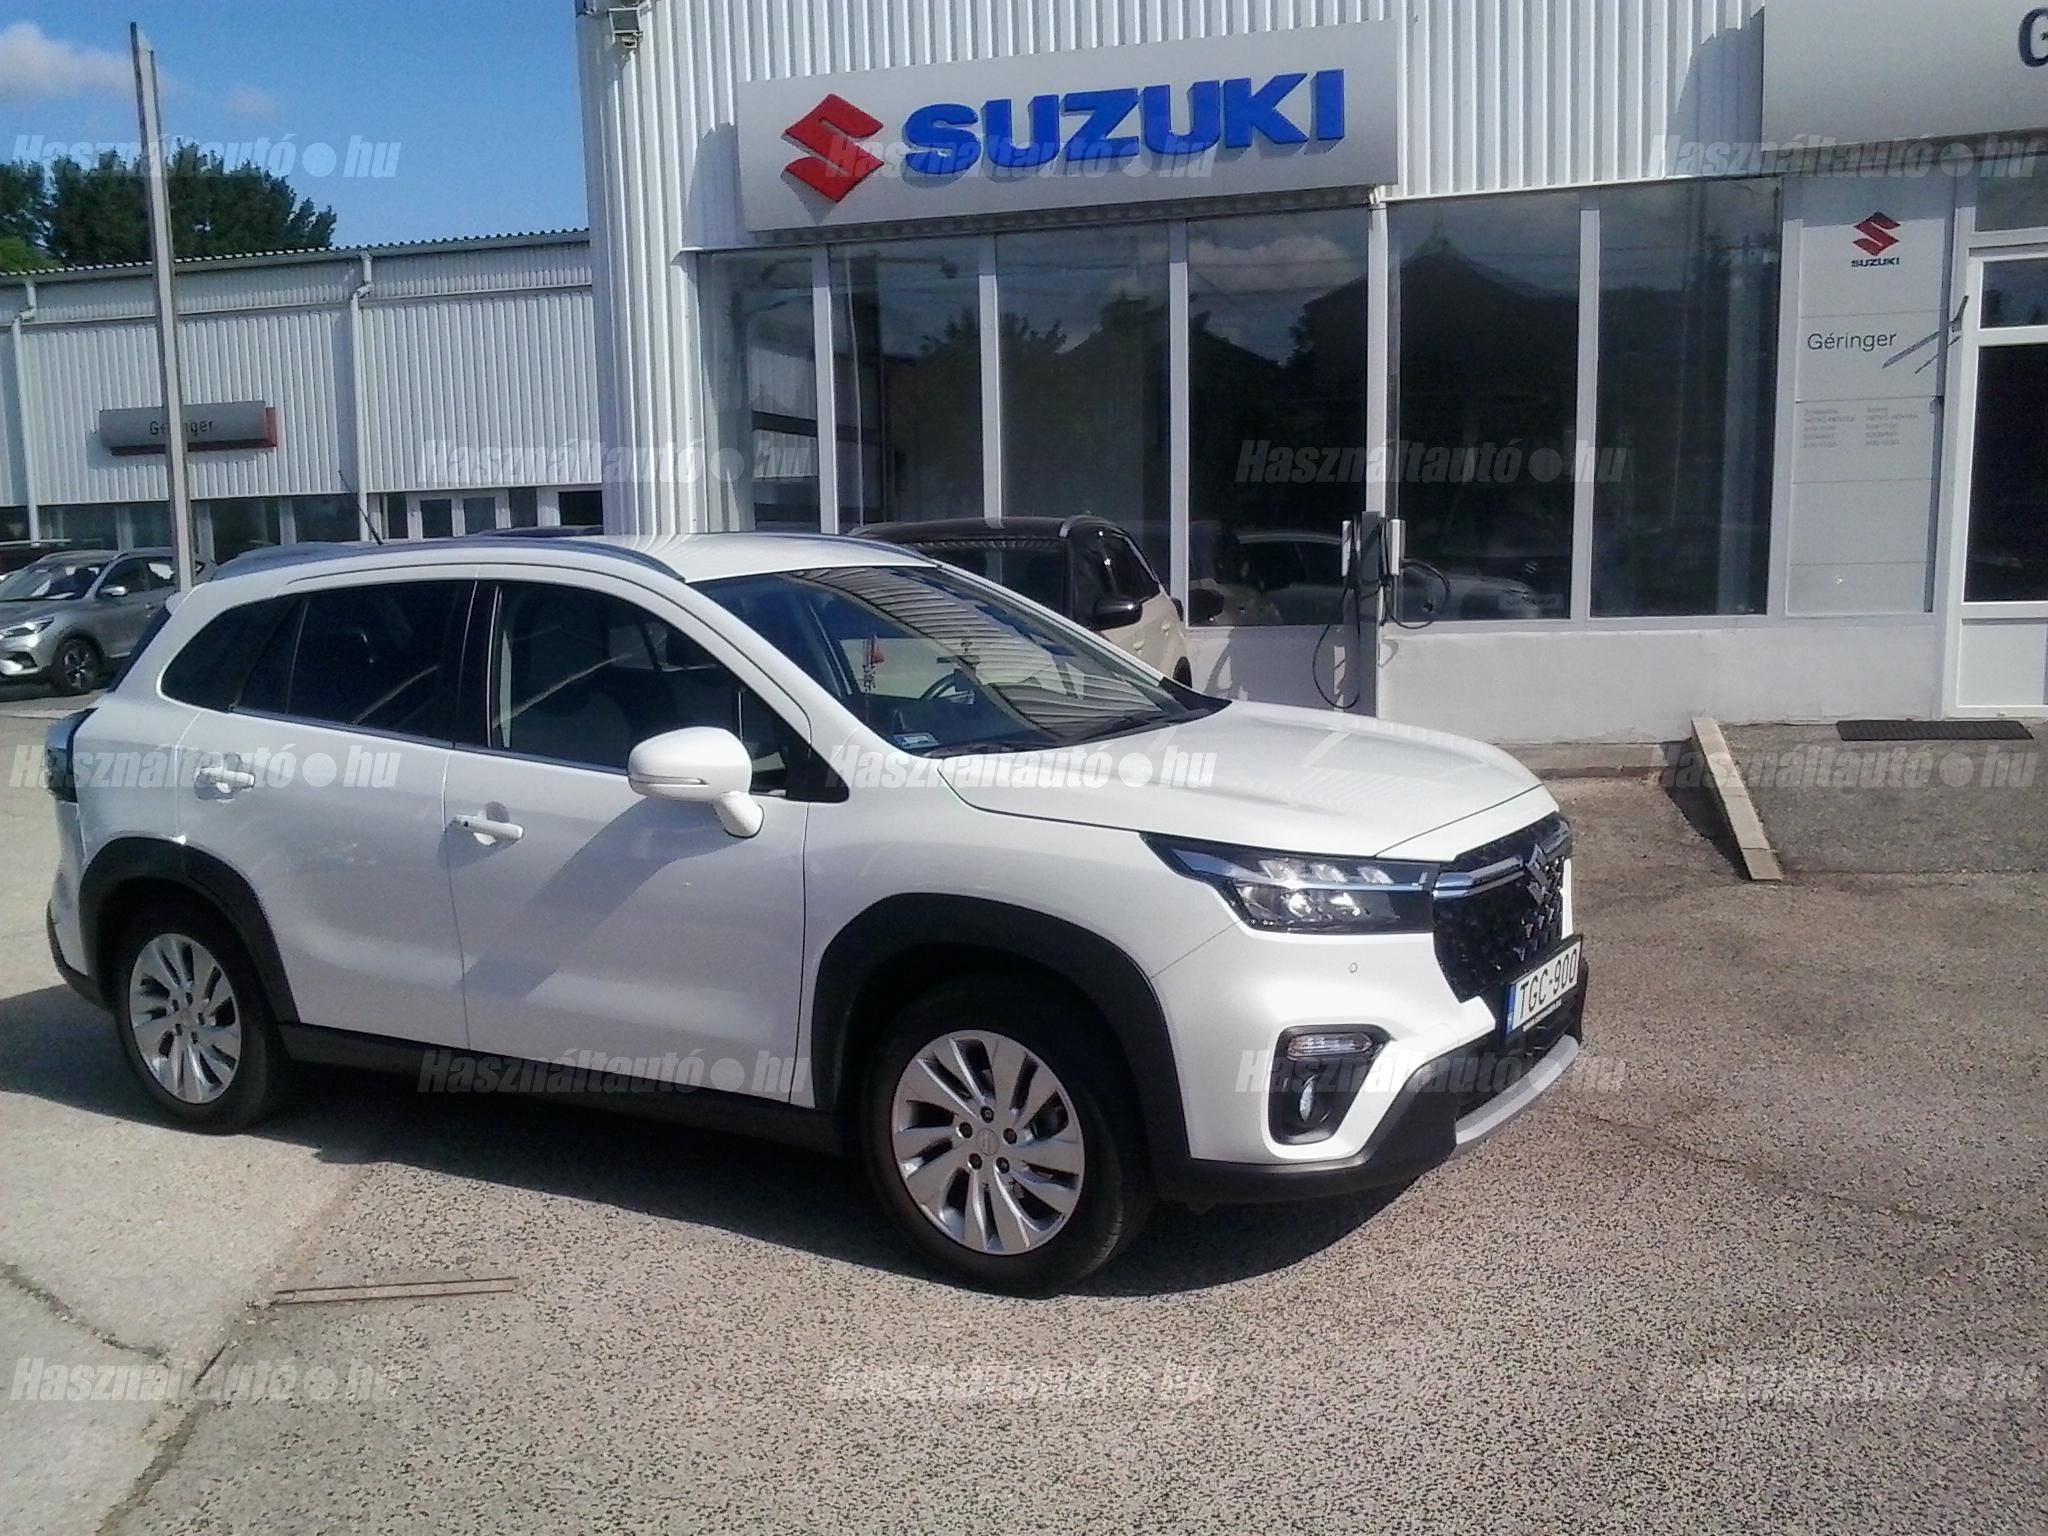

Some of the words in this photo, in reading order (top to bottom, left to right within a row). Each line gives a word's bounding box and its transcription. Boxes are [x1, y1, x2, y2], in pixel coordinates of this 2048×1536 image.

[903, 68, 1345, 180] SUZUKI
[1850, 257, 1900, 268] SUZUKI
[1807, 332, 1897, 352] Géringer
[1520, 948, 1577, 1019] TGC-900
